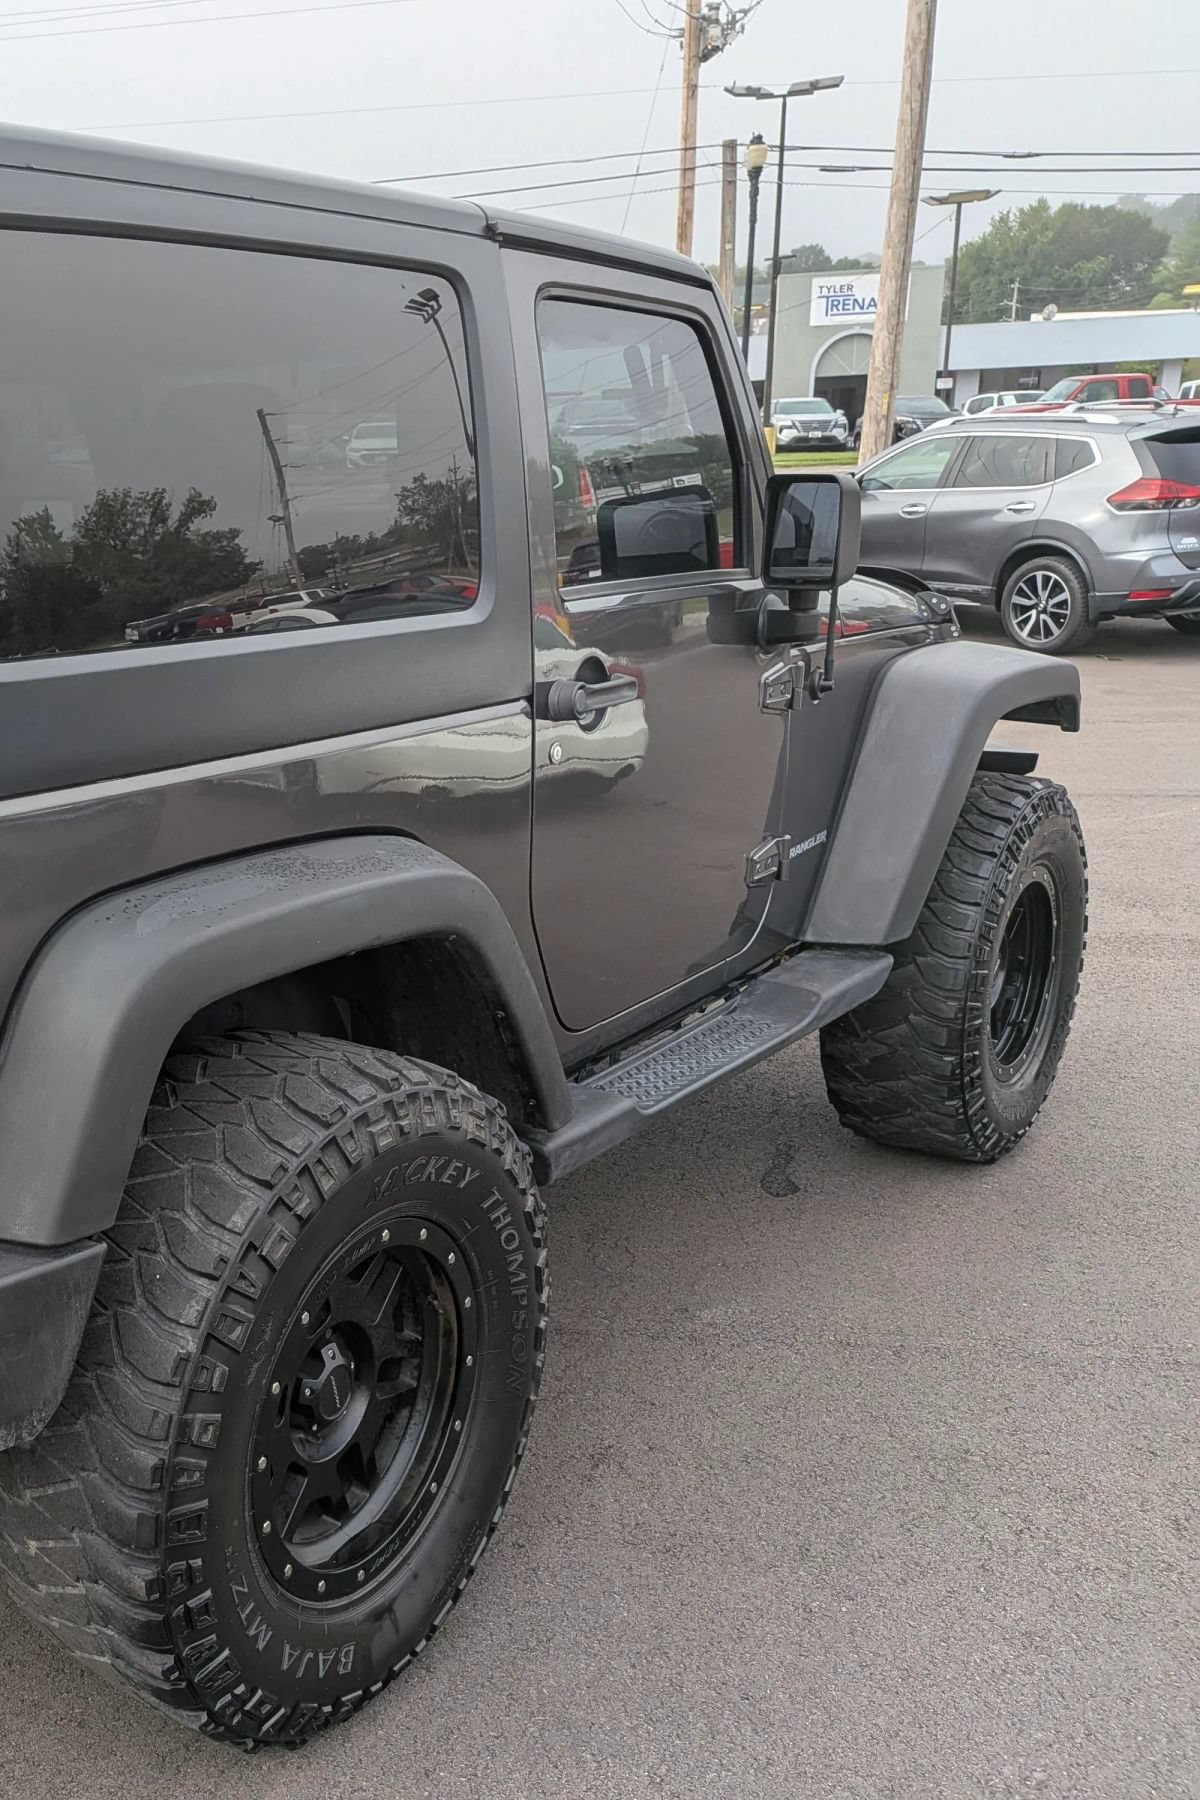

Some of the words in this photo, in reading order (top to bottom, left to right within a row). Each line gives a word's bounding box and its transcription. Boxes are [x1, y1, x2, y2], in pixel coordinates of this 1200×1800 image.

[817, 294, 878, 317] TRENA
[818, 284, 854, 294] TYLER
[789, 830, 827, 859] RANGLER
[365, 1155, 481, 1208] MICKEY
[480, 1186, 530, 1397] THOMPSON
[229, 1574, 273, 1652] MTZ
[280, 1640, 357, 1679] BAJA
